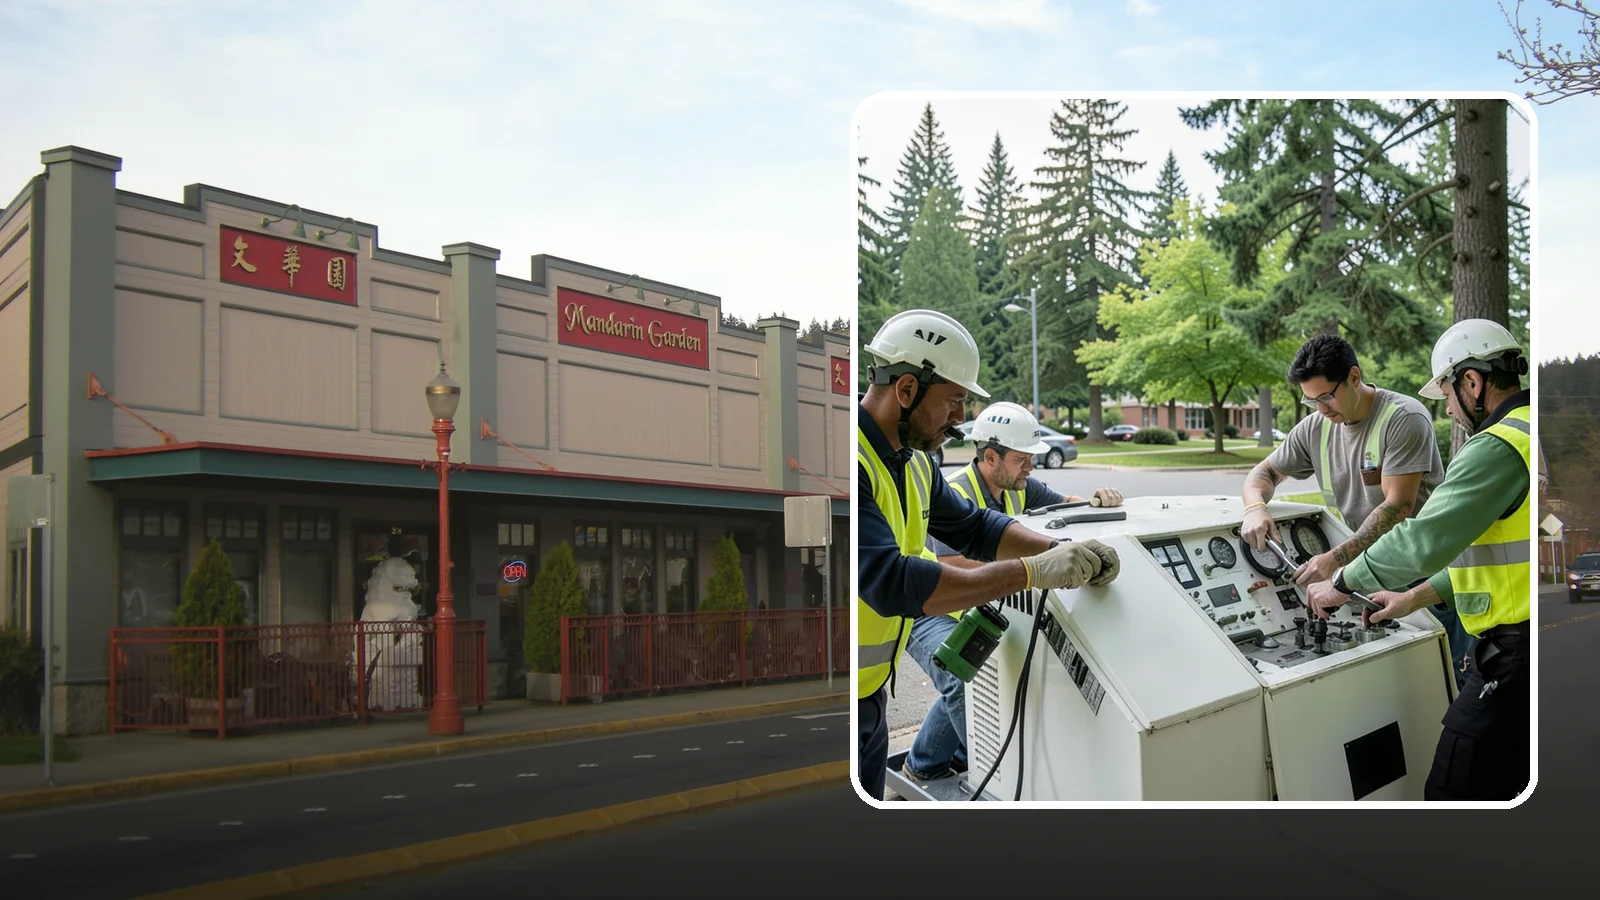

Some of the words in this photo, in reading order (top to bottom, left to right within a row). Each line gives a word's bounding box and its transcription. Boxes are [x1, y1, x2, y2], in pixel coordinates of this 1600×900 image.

[231, 235, 346, 291] 文華園
[564, 302, 644, 341] Mandarin
[648, 320, 701, 352] Garden
[503, 565, 527, 578] OPEN
